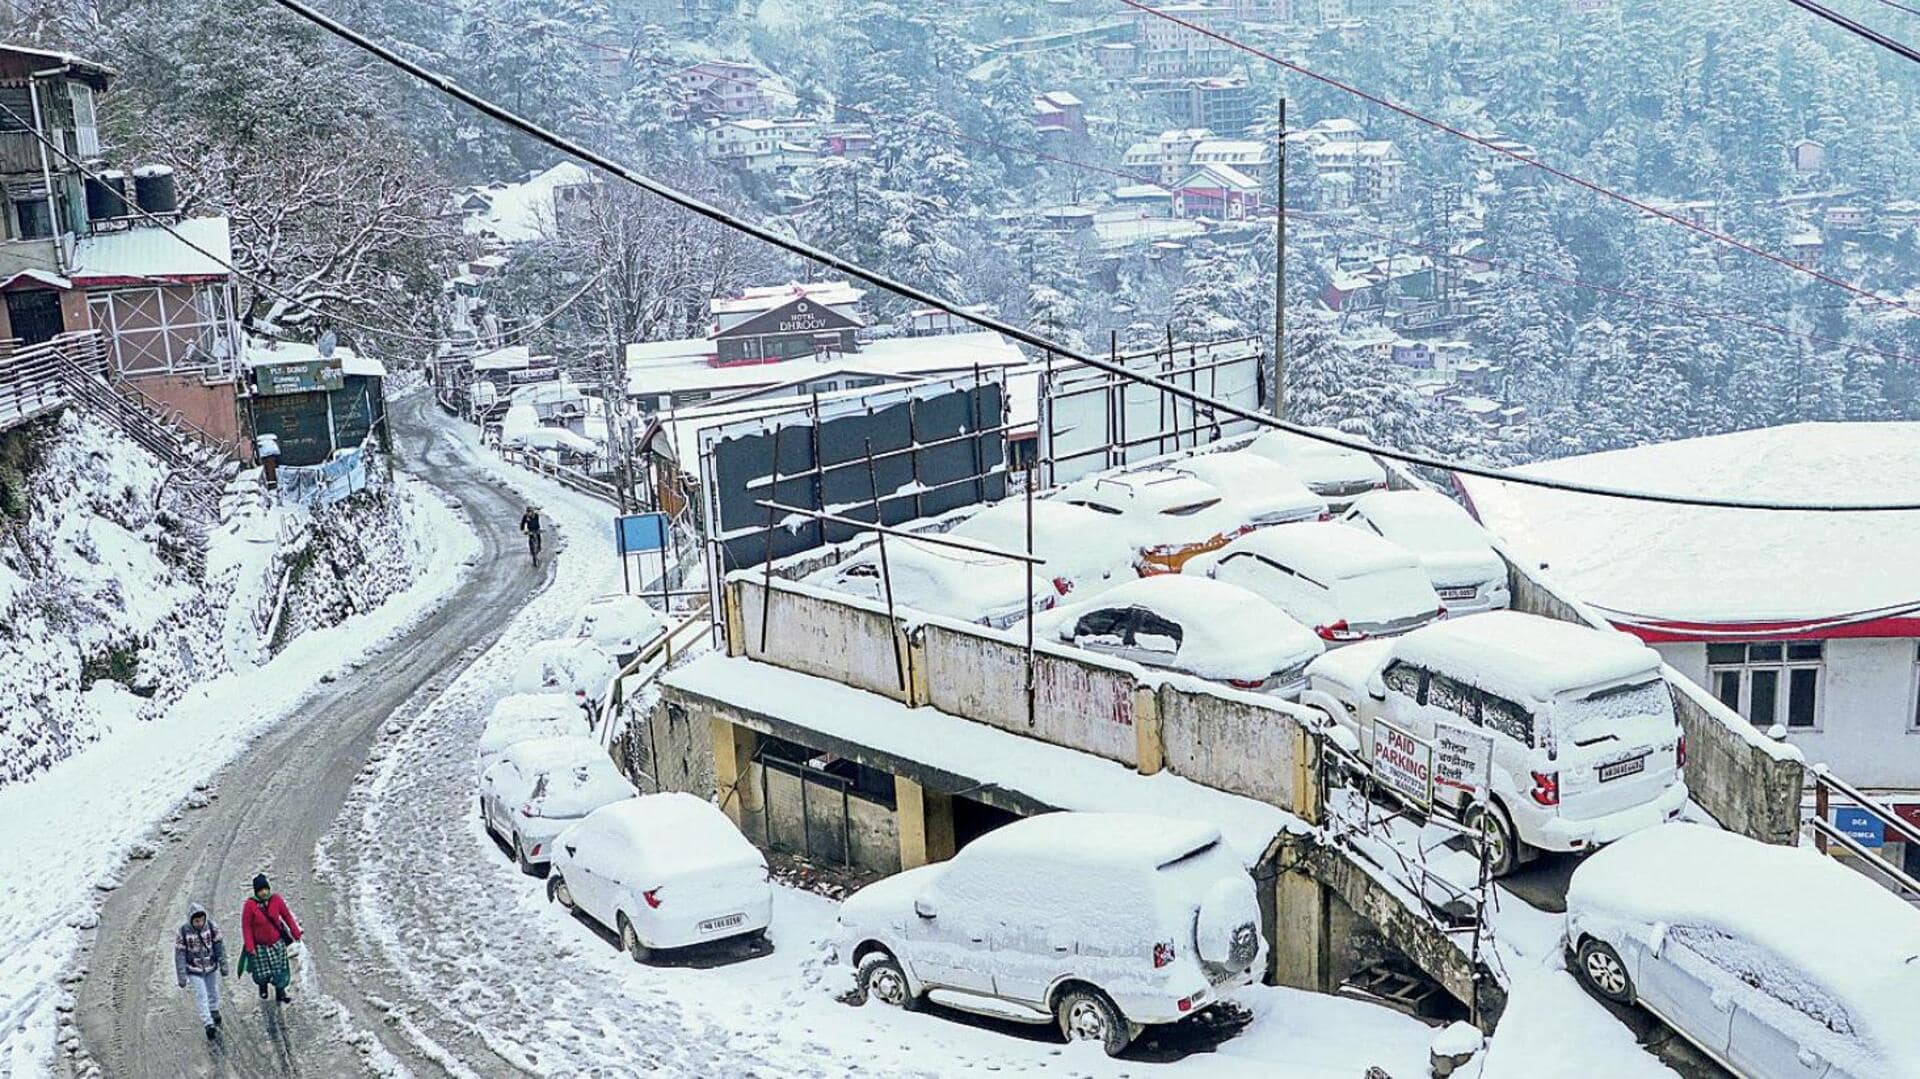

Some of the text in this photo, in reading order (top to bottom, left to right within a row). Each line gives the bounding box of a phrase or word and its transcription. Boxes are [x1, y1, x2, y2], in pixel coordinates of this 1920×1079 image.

[780, 319, 826, 331] DHROOV
[791, 312, 815, 321] HOTEL
[1388, 731, 1415, 756] PAID
[1375, 742, 1427, 781] PARKING
